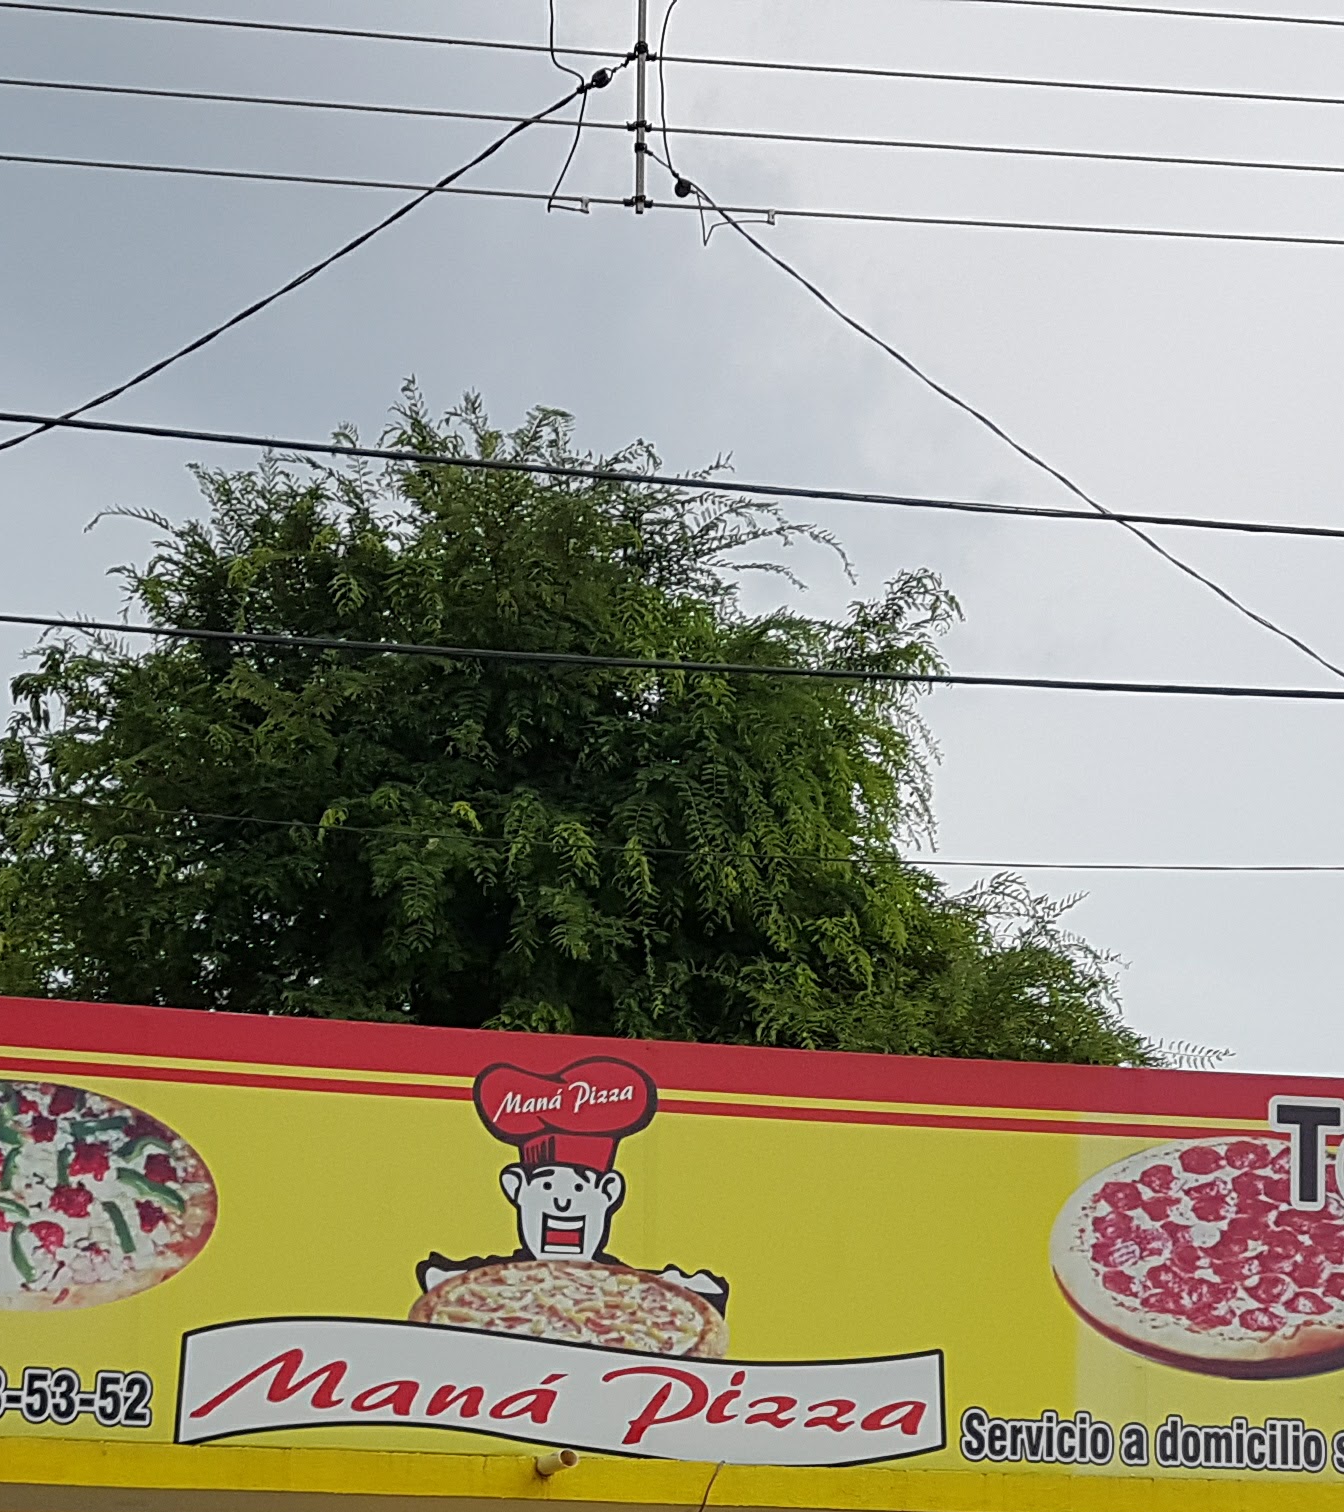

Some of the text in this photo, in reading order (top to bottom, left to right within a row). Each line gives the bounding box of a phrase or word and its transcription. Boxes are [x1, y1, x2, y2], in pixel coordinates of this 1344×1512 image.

[492, 1081, 635, 1123] Maná Pizza
[188, 1347, 926, 1446] Maná Pizza
[960, 1407, 1114, 1464] Servicio
[1122, 1423, 1150, 1466] a
[1158, 1414, 1326, 1474] domicilio
